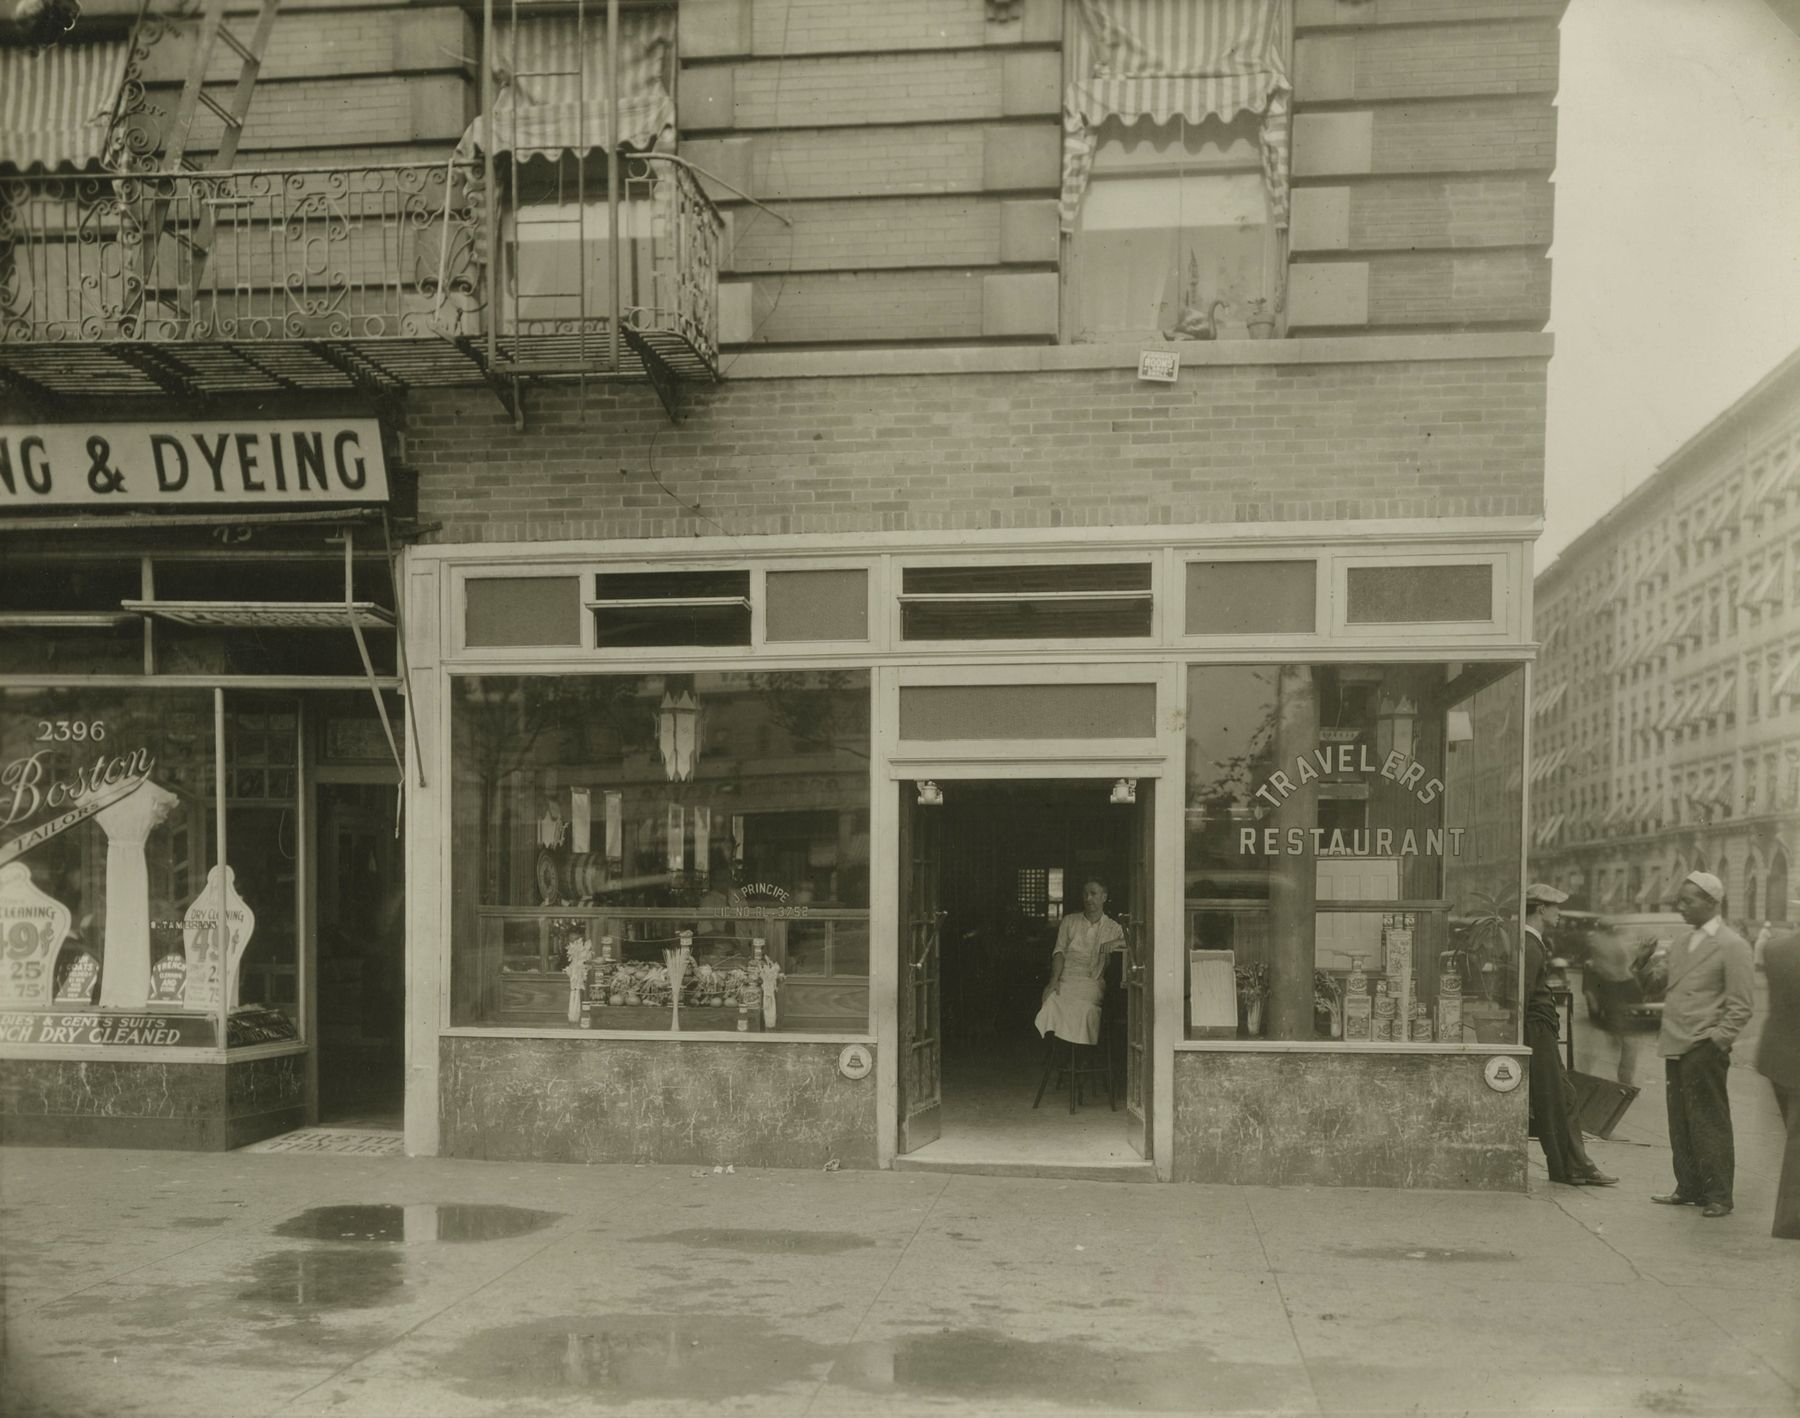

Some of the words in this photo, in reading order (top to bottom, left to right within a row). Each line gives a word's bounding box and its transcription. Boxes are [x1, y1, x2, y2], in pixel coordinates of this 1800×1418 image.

[86, 435, 127, 493] &
[149, 430, 367, 493] DYEING
[36, 720, 105, 741] 2396
[1255, 744, 1446, 808] TRAVELERS
[0, 747, 155, 829] Boston
[14, 801, 100, 851] TAILORS
[1238, 827, 1466, 856] RESTAURANT
[740, 883, 790, 904] PRINCIPE
[0, 906, 56, 921] LEANING
[208, 908, 245, 923] CLENING
[43, 1015, 54, 1026] &
[119, 1017, 167, 1030] SUITS
[38, 1026, 83, 1043] DRY
[88, 1027, 181, 1046] CLEANED
[280, 1133, 405, 1146] BOSTO
